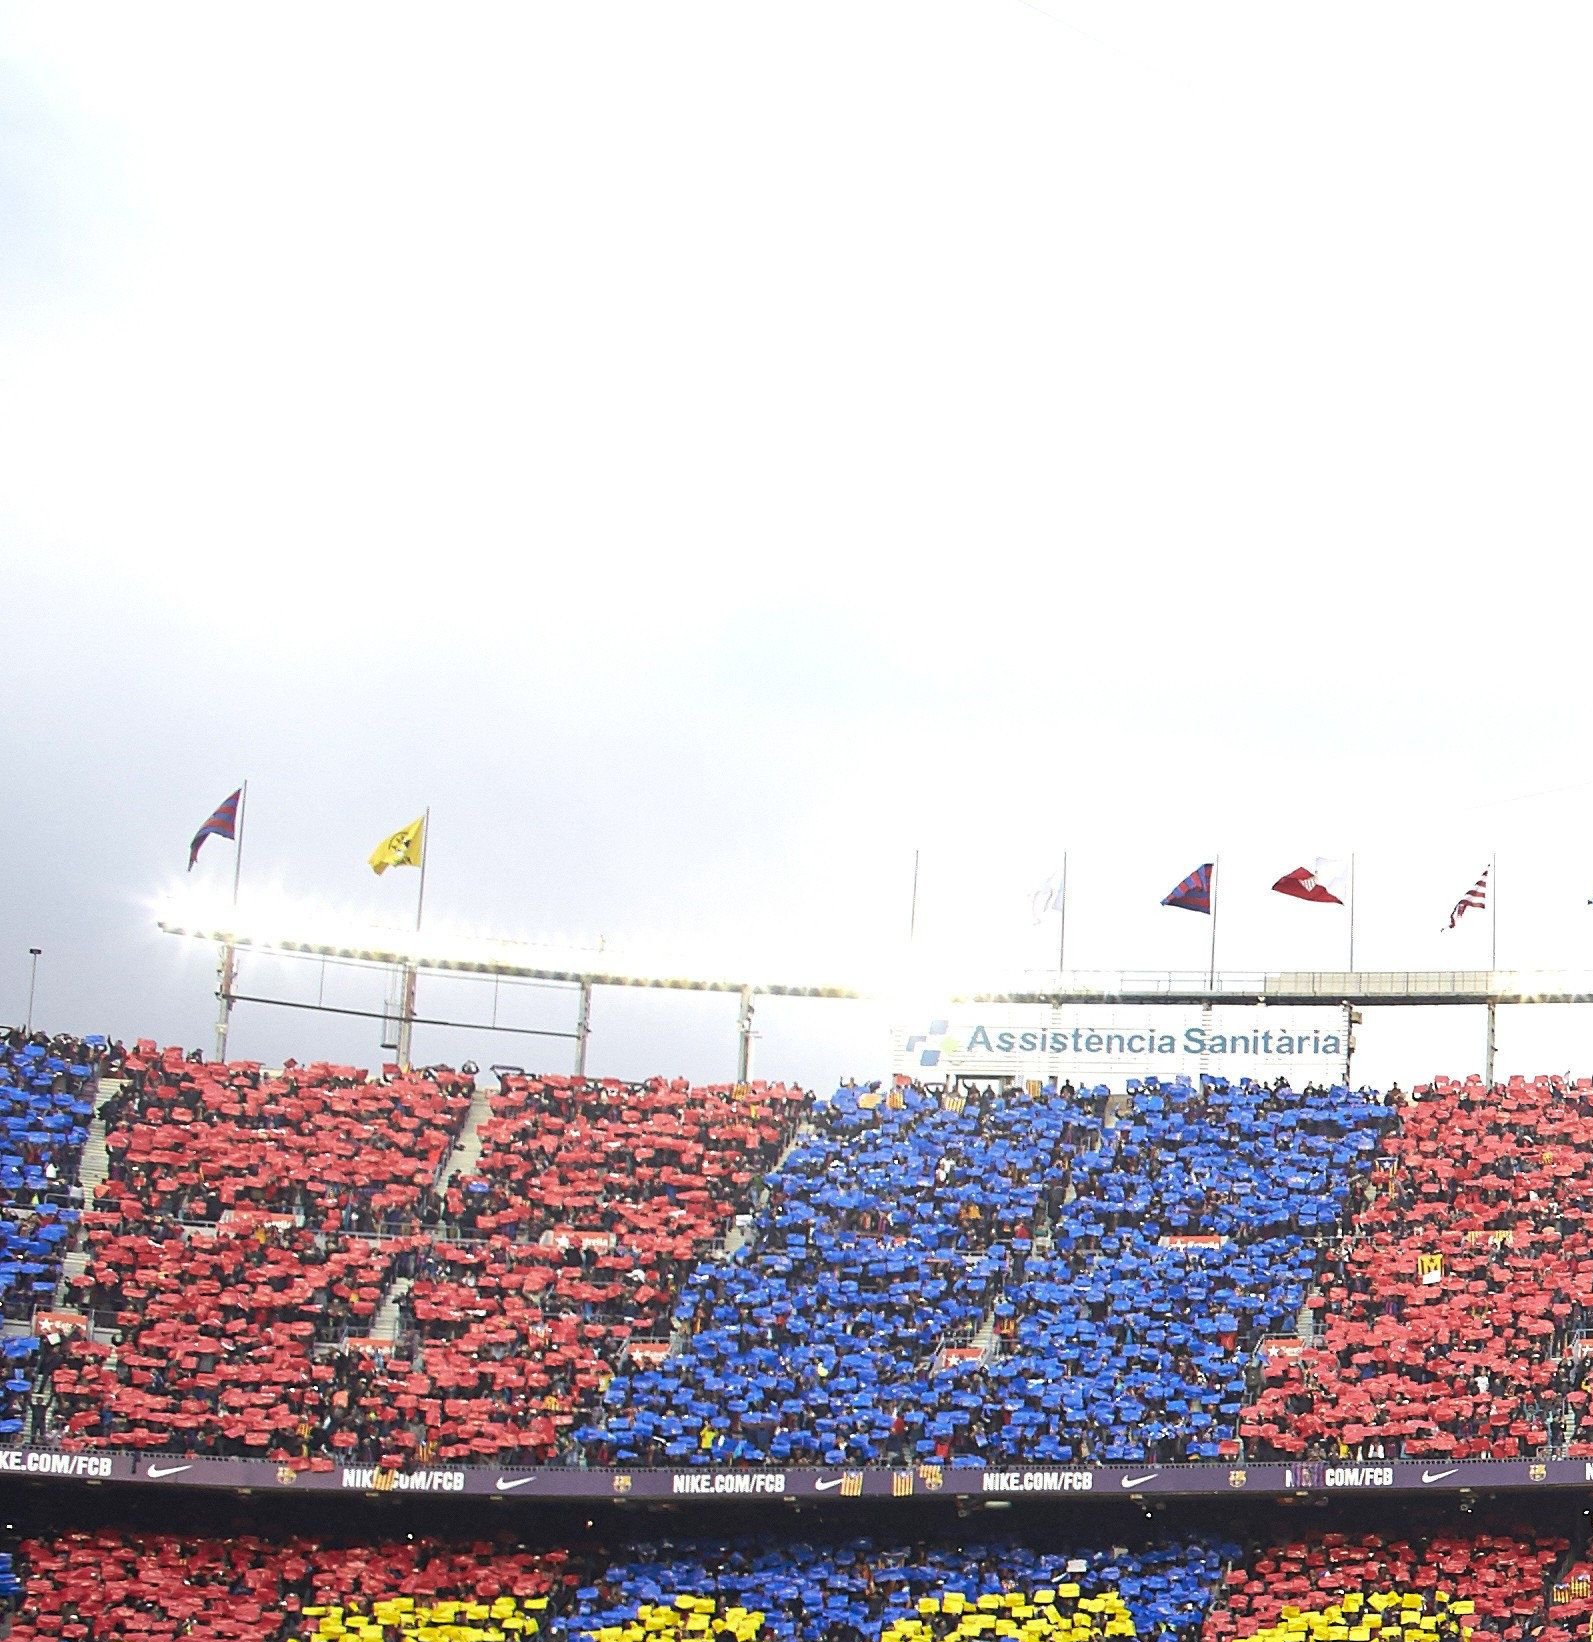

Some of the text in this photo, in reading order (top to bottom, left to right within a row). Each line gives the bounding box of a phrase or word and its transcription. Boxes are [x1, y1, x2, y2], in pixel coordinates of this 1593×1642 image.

[966, 1025, 1341, 1056] Assistència Sanitària
[0, 1450, 113, 1478] KE.COM/FCB
[672, 1473, 786, 1494] NIKE.COM/FCB
[982, 1471, 1093, 1491] NIKE.COM/FCB
[1285, 1467, 1394, 1487] NCOM/FCB
